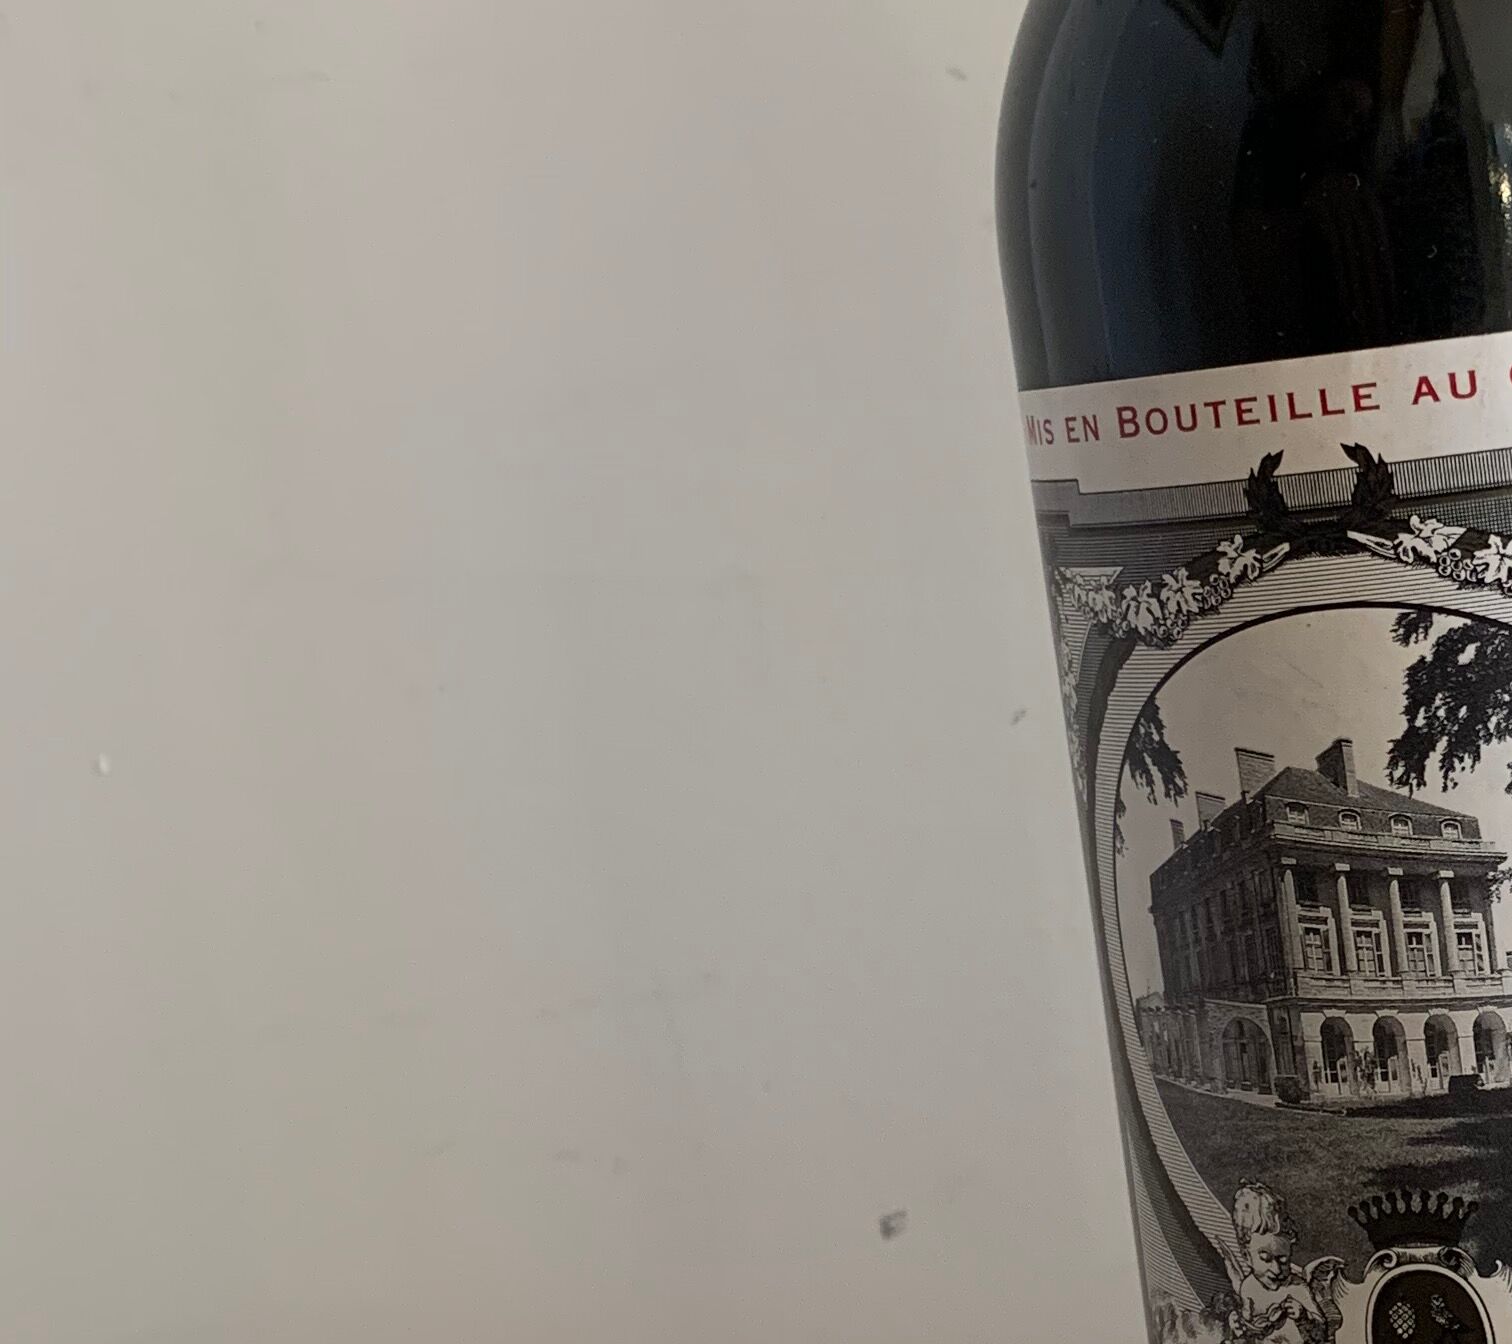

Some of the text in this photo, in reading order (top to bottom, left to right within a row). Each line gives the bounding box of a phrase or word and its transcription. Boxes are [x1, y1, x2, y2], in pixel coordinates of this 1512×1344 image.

[1026, 415, 1055, 445] MIS
[1065, 414, 1100, 443] EN
[1116, 382, 1380, 438] BOUTEILLE
[1411, 369, 1478, 405] AU
